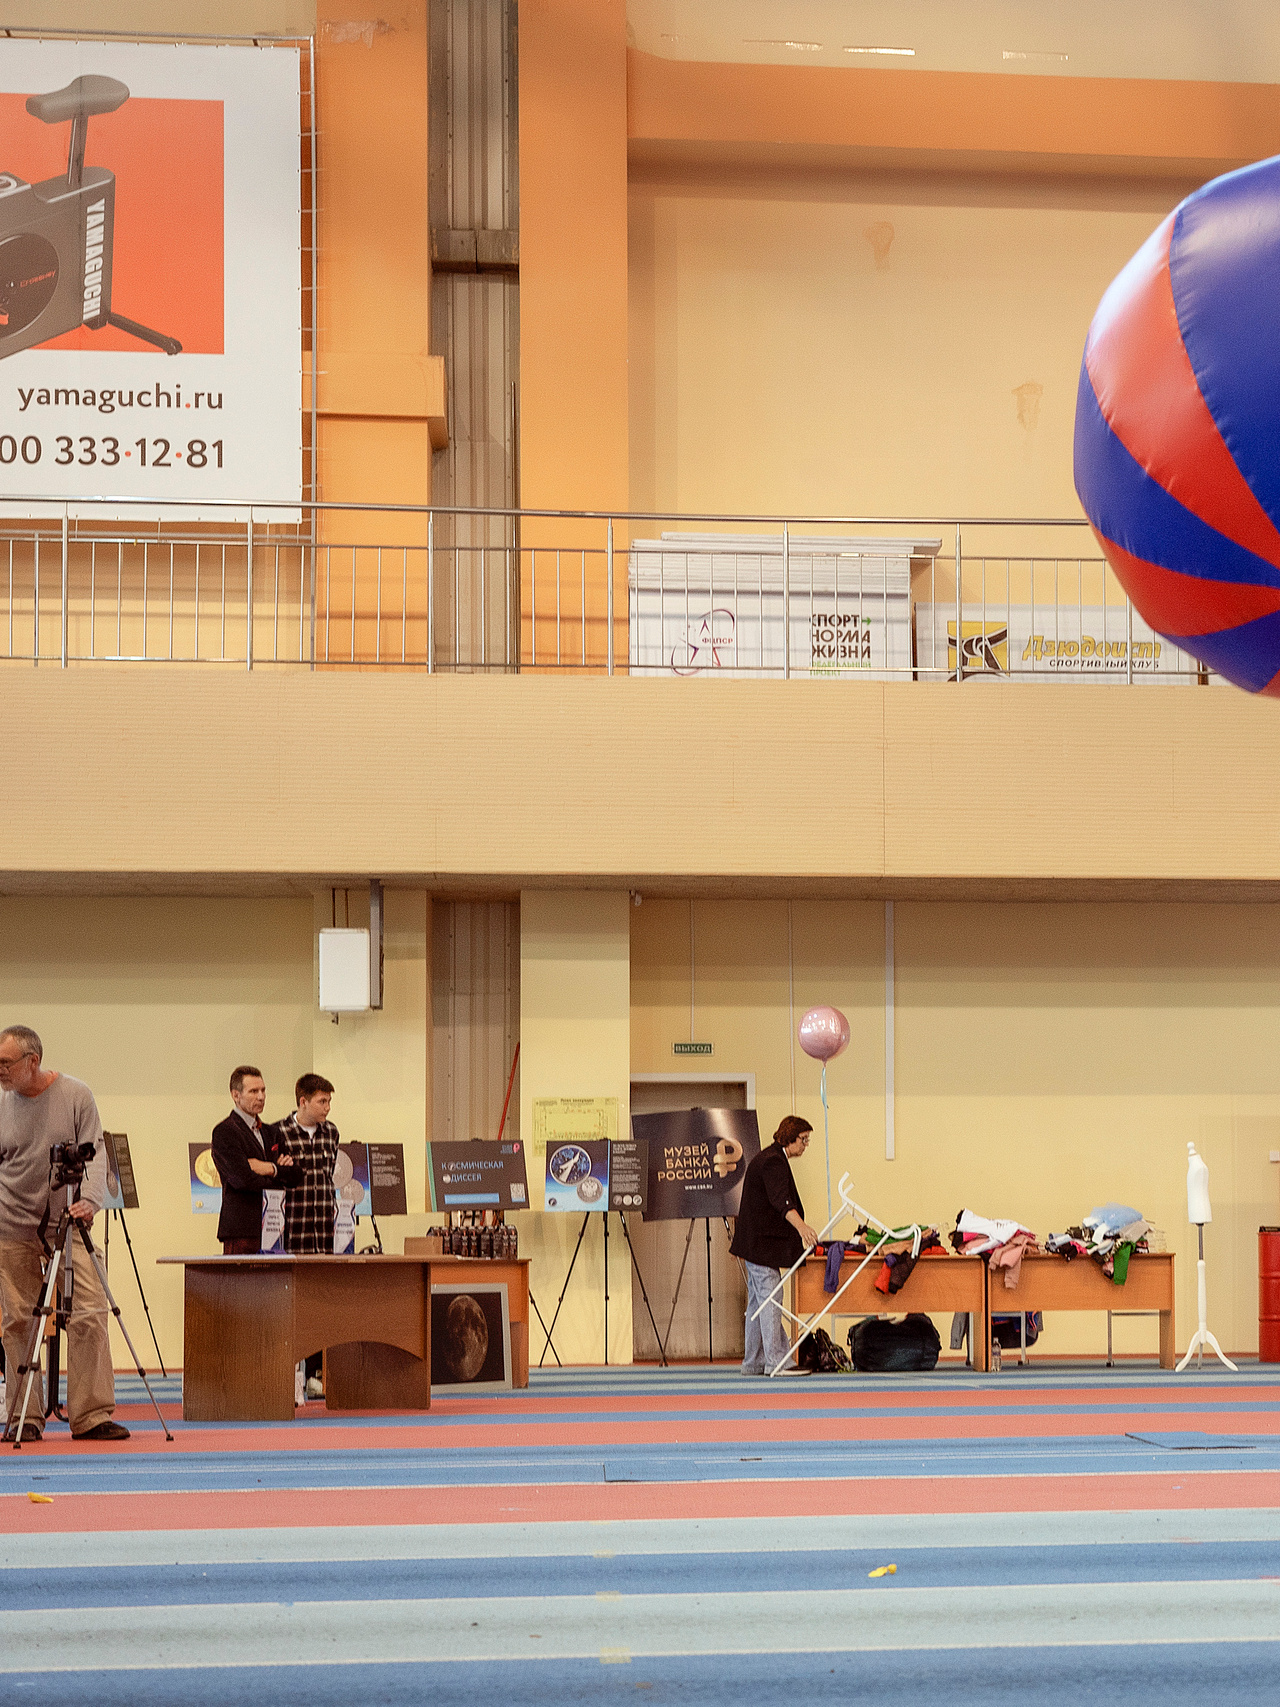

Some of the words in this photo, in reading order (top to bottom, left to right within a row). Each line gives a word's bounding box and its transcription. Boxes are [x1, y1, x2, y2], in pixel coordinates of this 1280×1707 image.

[82, 197, 106, 321] YAMAGUCHI
[17, 382, 223, 414] yamaguchi.ru
[809, 645, 871, 659] ЖИЗНИ
[1021, 635, 1162, 661] Дзюдоист
[675, 1044, 712, 1053] ВЫХОД
[663, 1142, 710, 1158] МУЗЕЙ
[665, 1156, 711, 1170] БАНКА
[657, 1168, 712, 1182] РОССИИ
